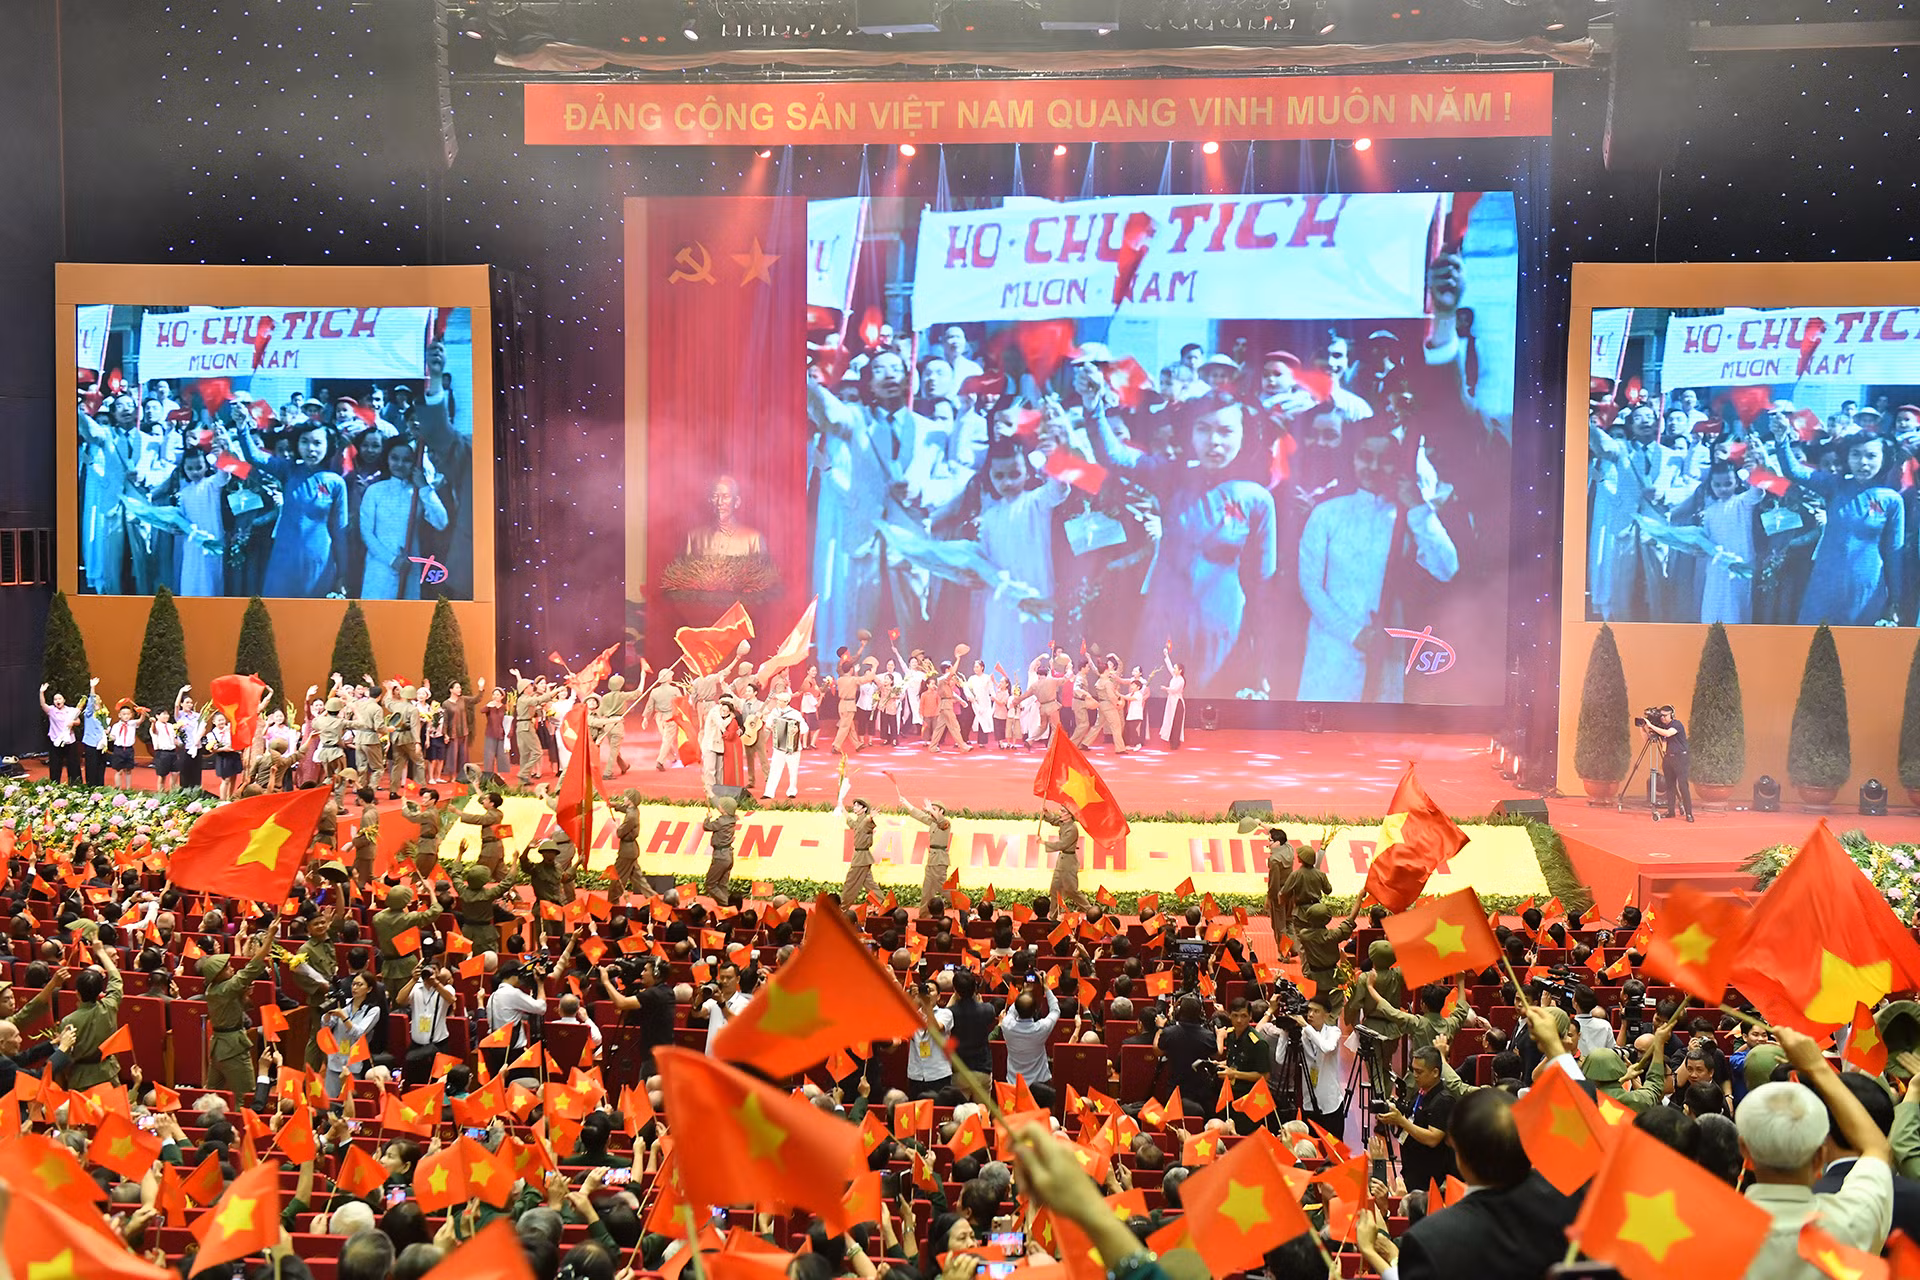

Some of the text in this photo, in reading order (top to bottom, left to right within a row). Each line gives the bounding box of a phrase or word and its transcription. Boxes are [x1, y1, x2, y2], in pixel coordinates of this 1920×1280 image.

[564, 92, 662, 131] ĐẢNG
[674, 96, 774, 138] CỘNG
[786, 92, 857, 131] SẢN
[870, 94, 945, 137] VIỆT
[958, 100, 1034, 129] NAM
[1047, 98, 1177, 130] QUANG
[1189, 96, 1273, 127] VINH
[1286, 88, 1396, 126] MUÔN
[1410, 86, 1493, 123] NĂM
[1167, 196, 1346, 253] TICH
[1001, 277, 1088, 308] MUON
[282, 307, 381, 339] TICH
[1834, 309, 1920, 343] TIC
[188, 352, 240, 371] MUON
[1721, 359, 1780, 378] MUON
